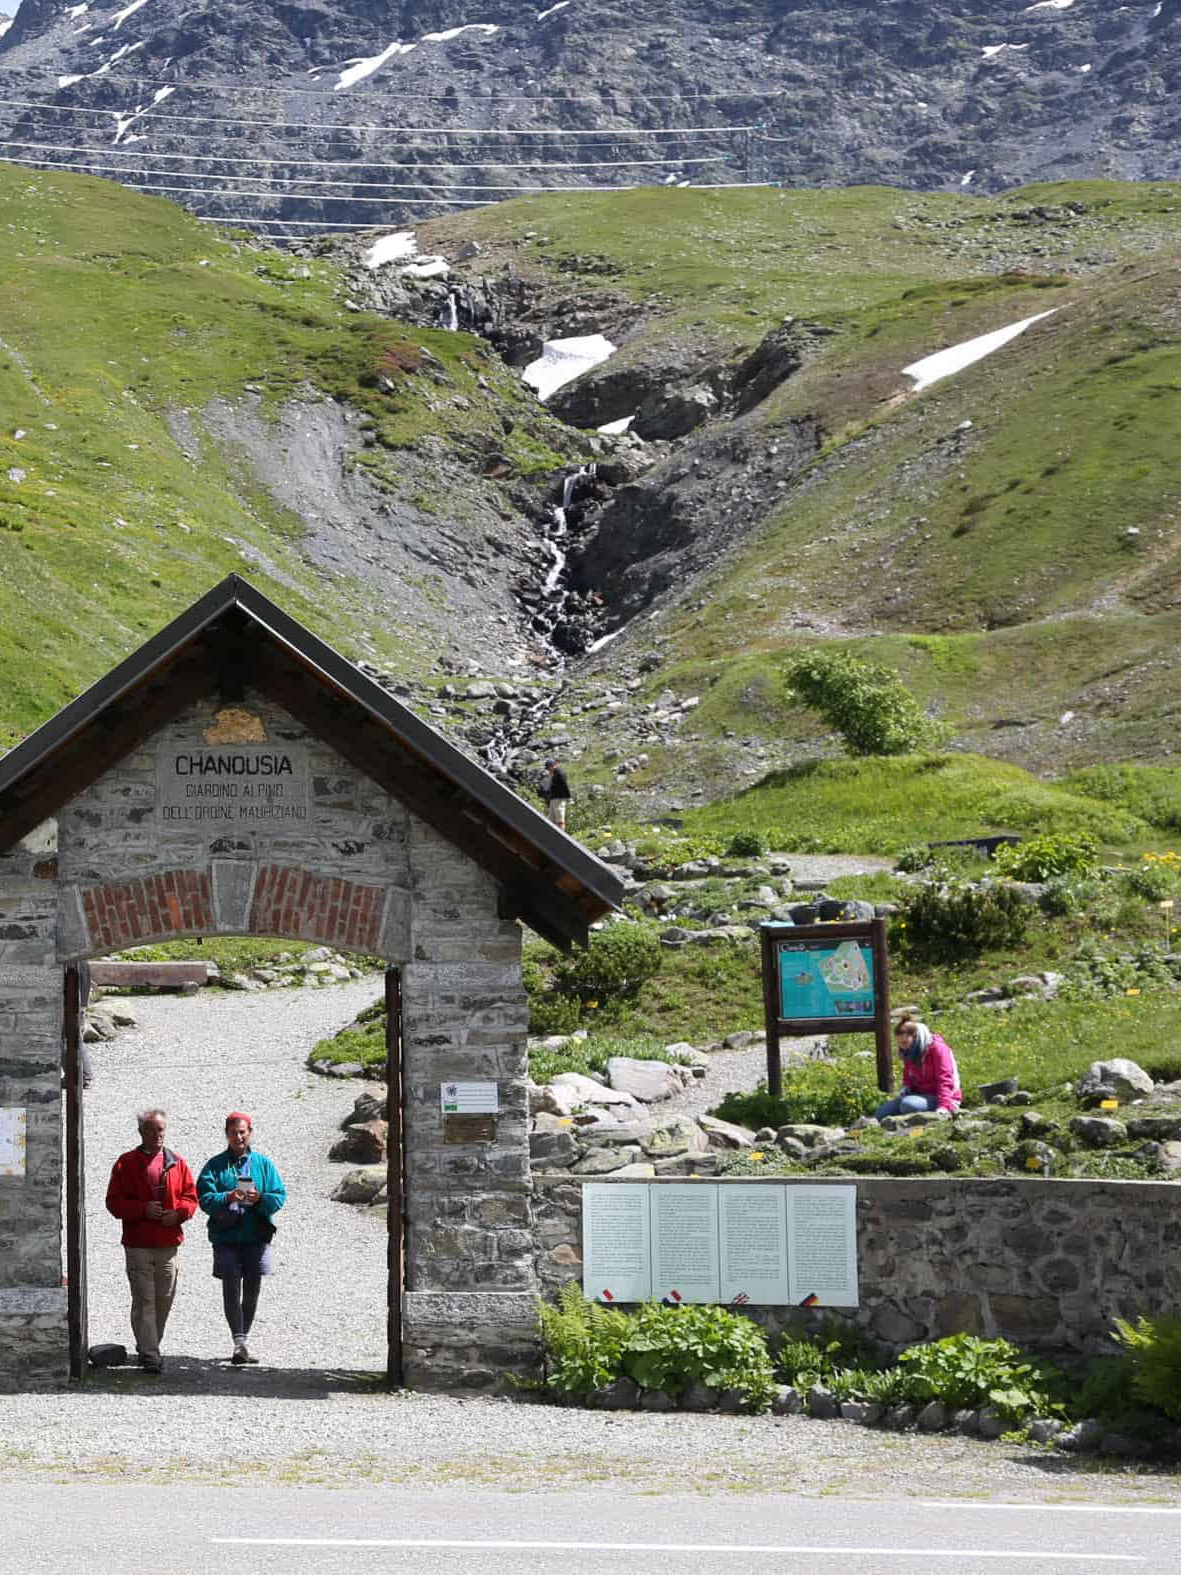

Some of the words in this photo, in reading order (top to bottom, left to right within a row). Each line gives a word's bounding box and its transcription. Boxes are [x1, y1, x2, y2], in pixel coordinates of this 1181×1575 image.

[176, 755, 293, 776] CHANOUSIA
[186, 783, 238, 798] GIARDINO
[243, 783, 283, 798] ALPINO
